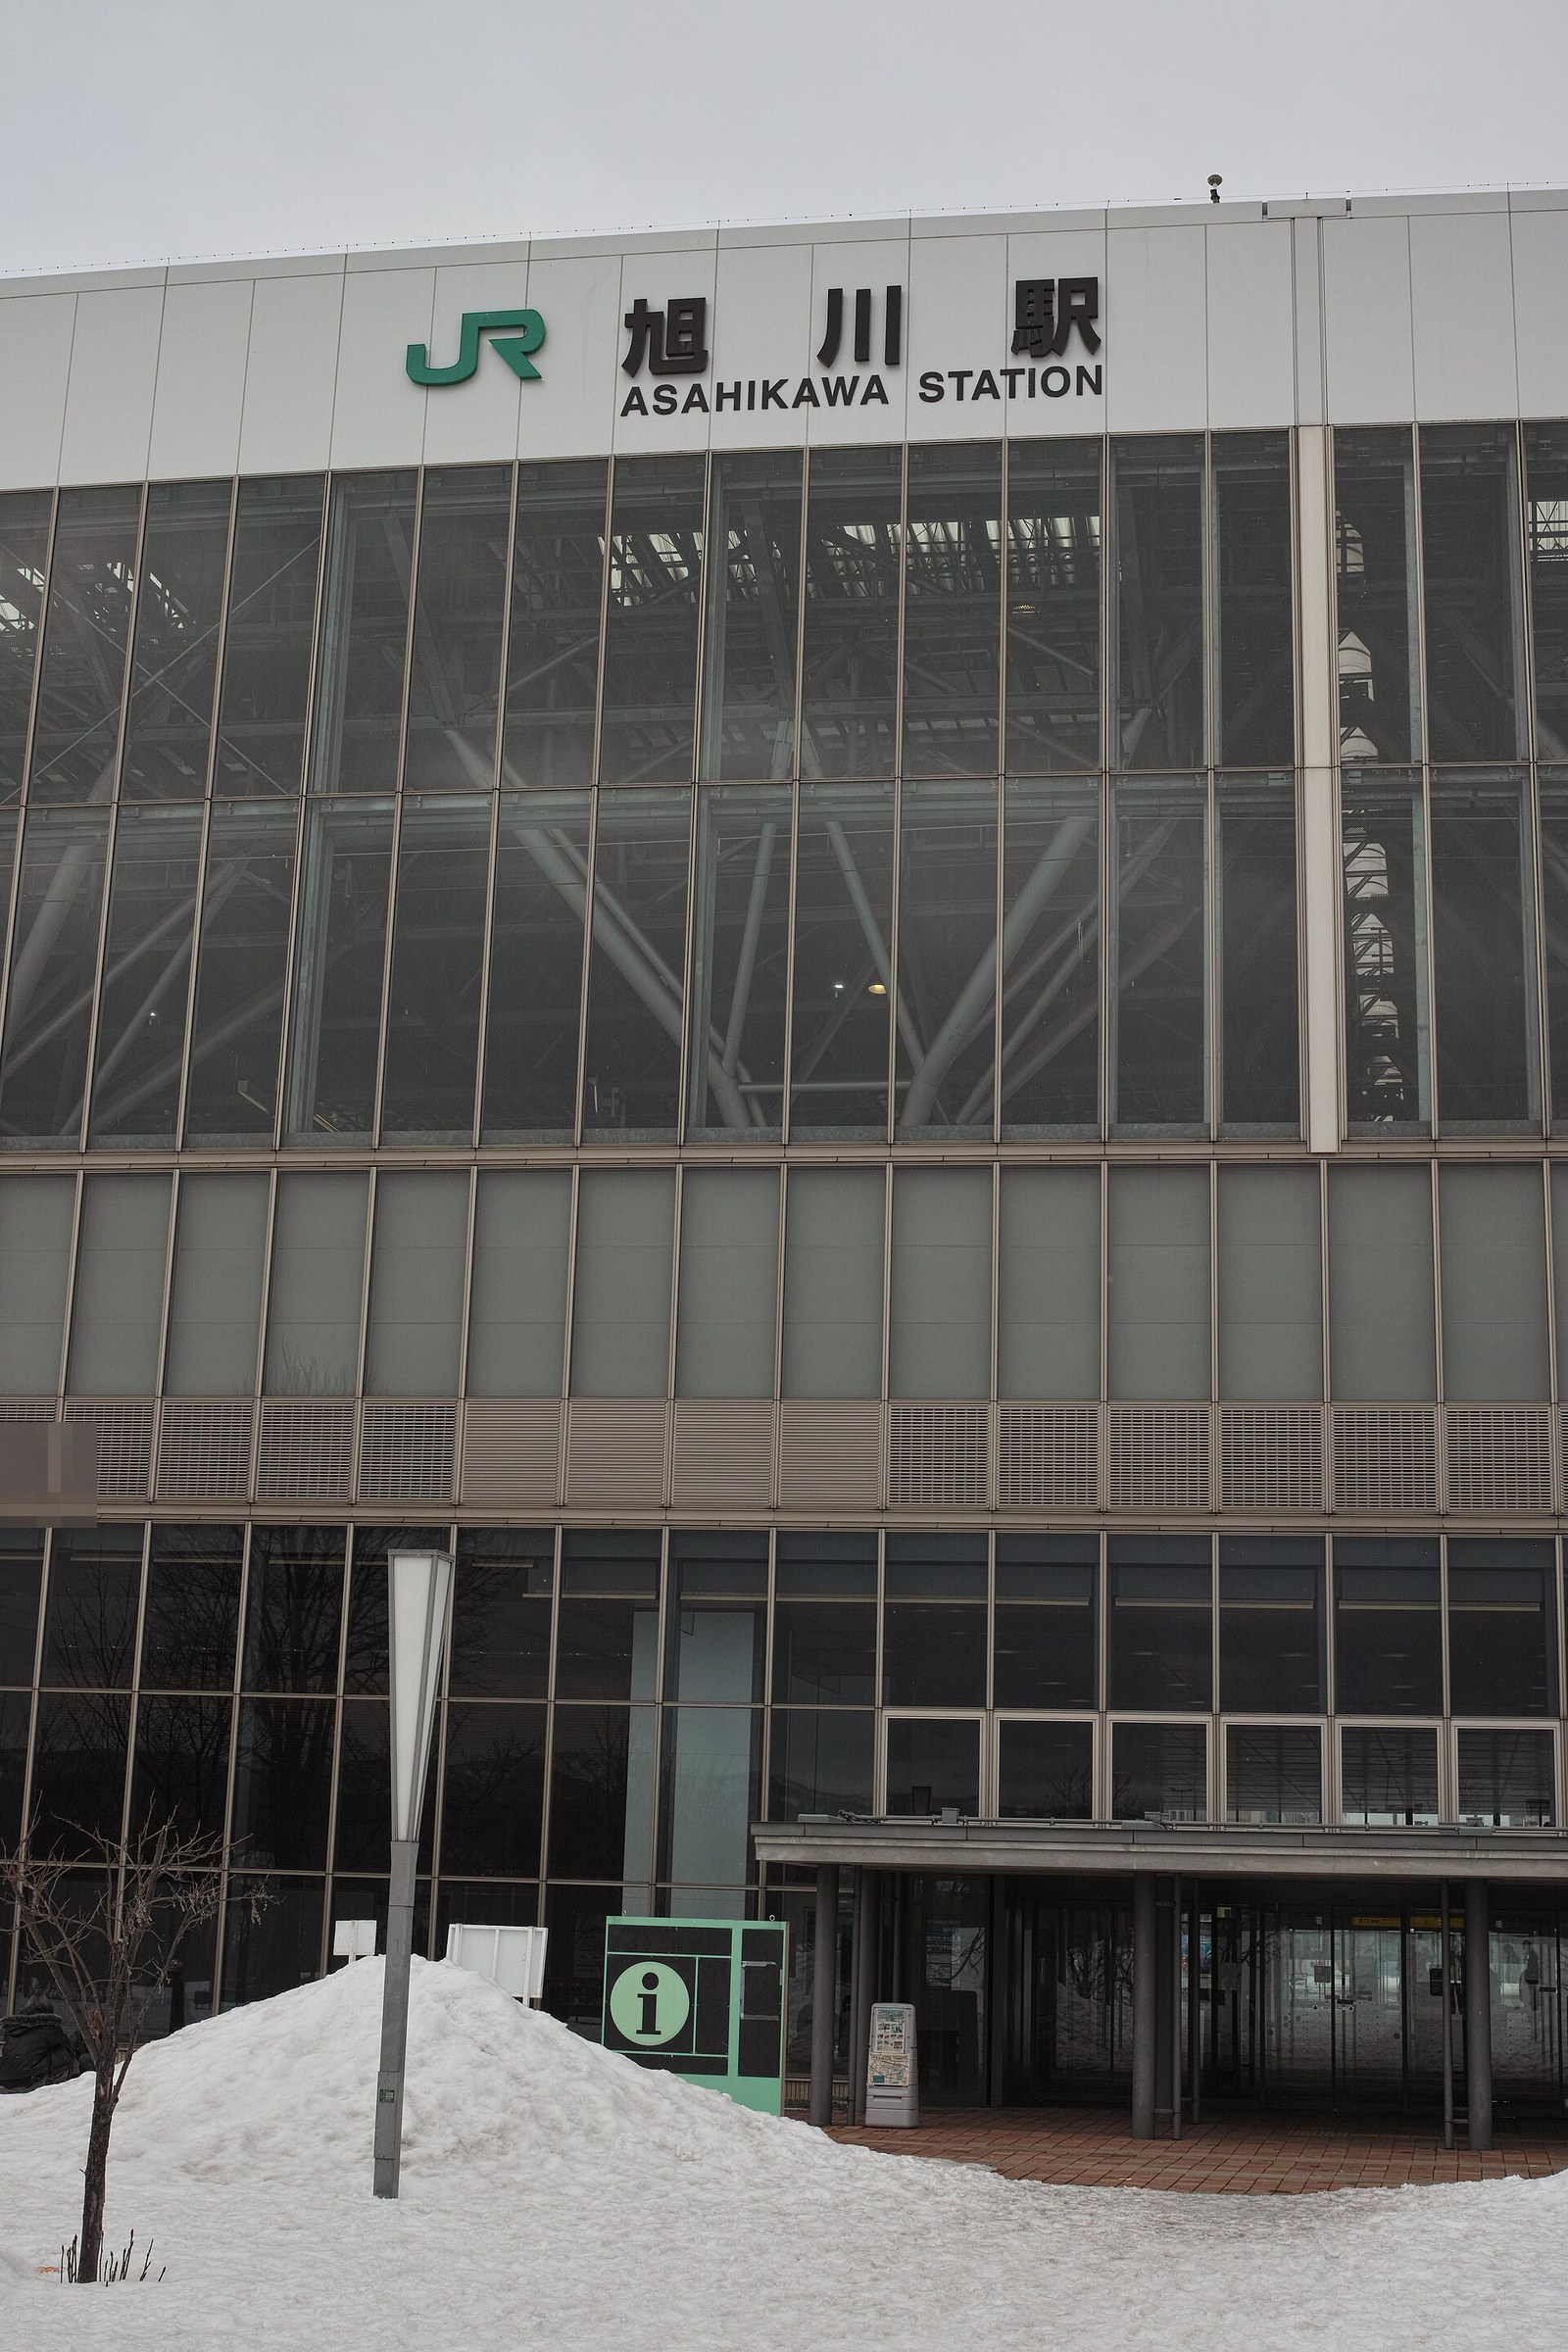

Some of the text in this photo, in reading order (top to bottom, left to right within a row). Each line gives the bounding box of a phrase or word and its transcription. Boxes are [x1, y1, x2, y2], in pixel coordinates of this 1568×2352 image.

[406, 309, 546, 387] JR
[620, 365, 1102, 417] ASAHIKAWA STATION
